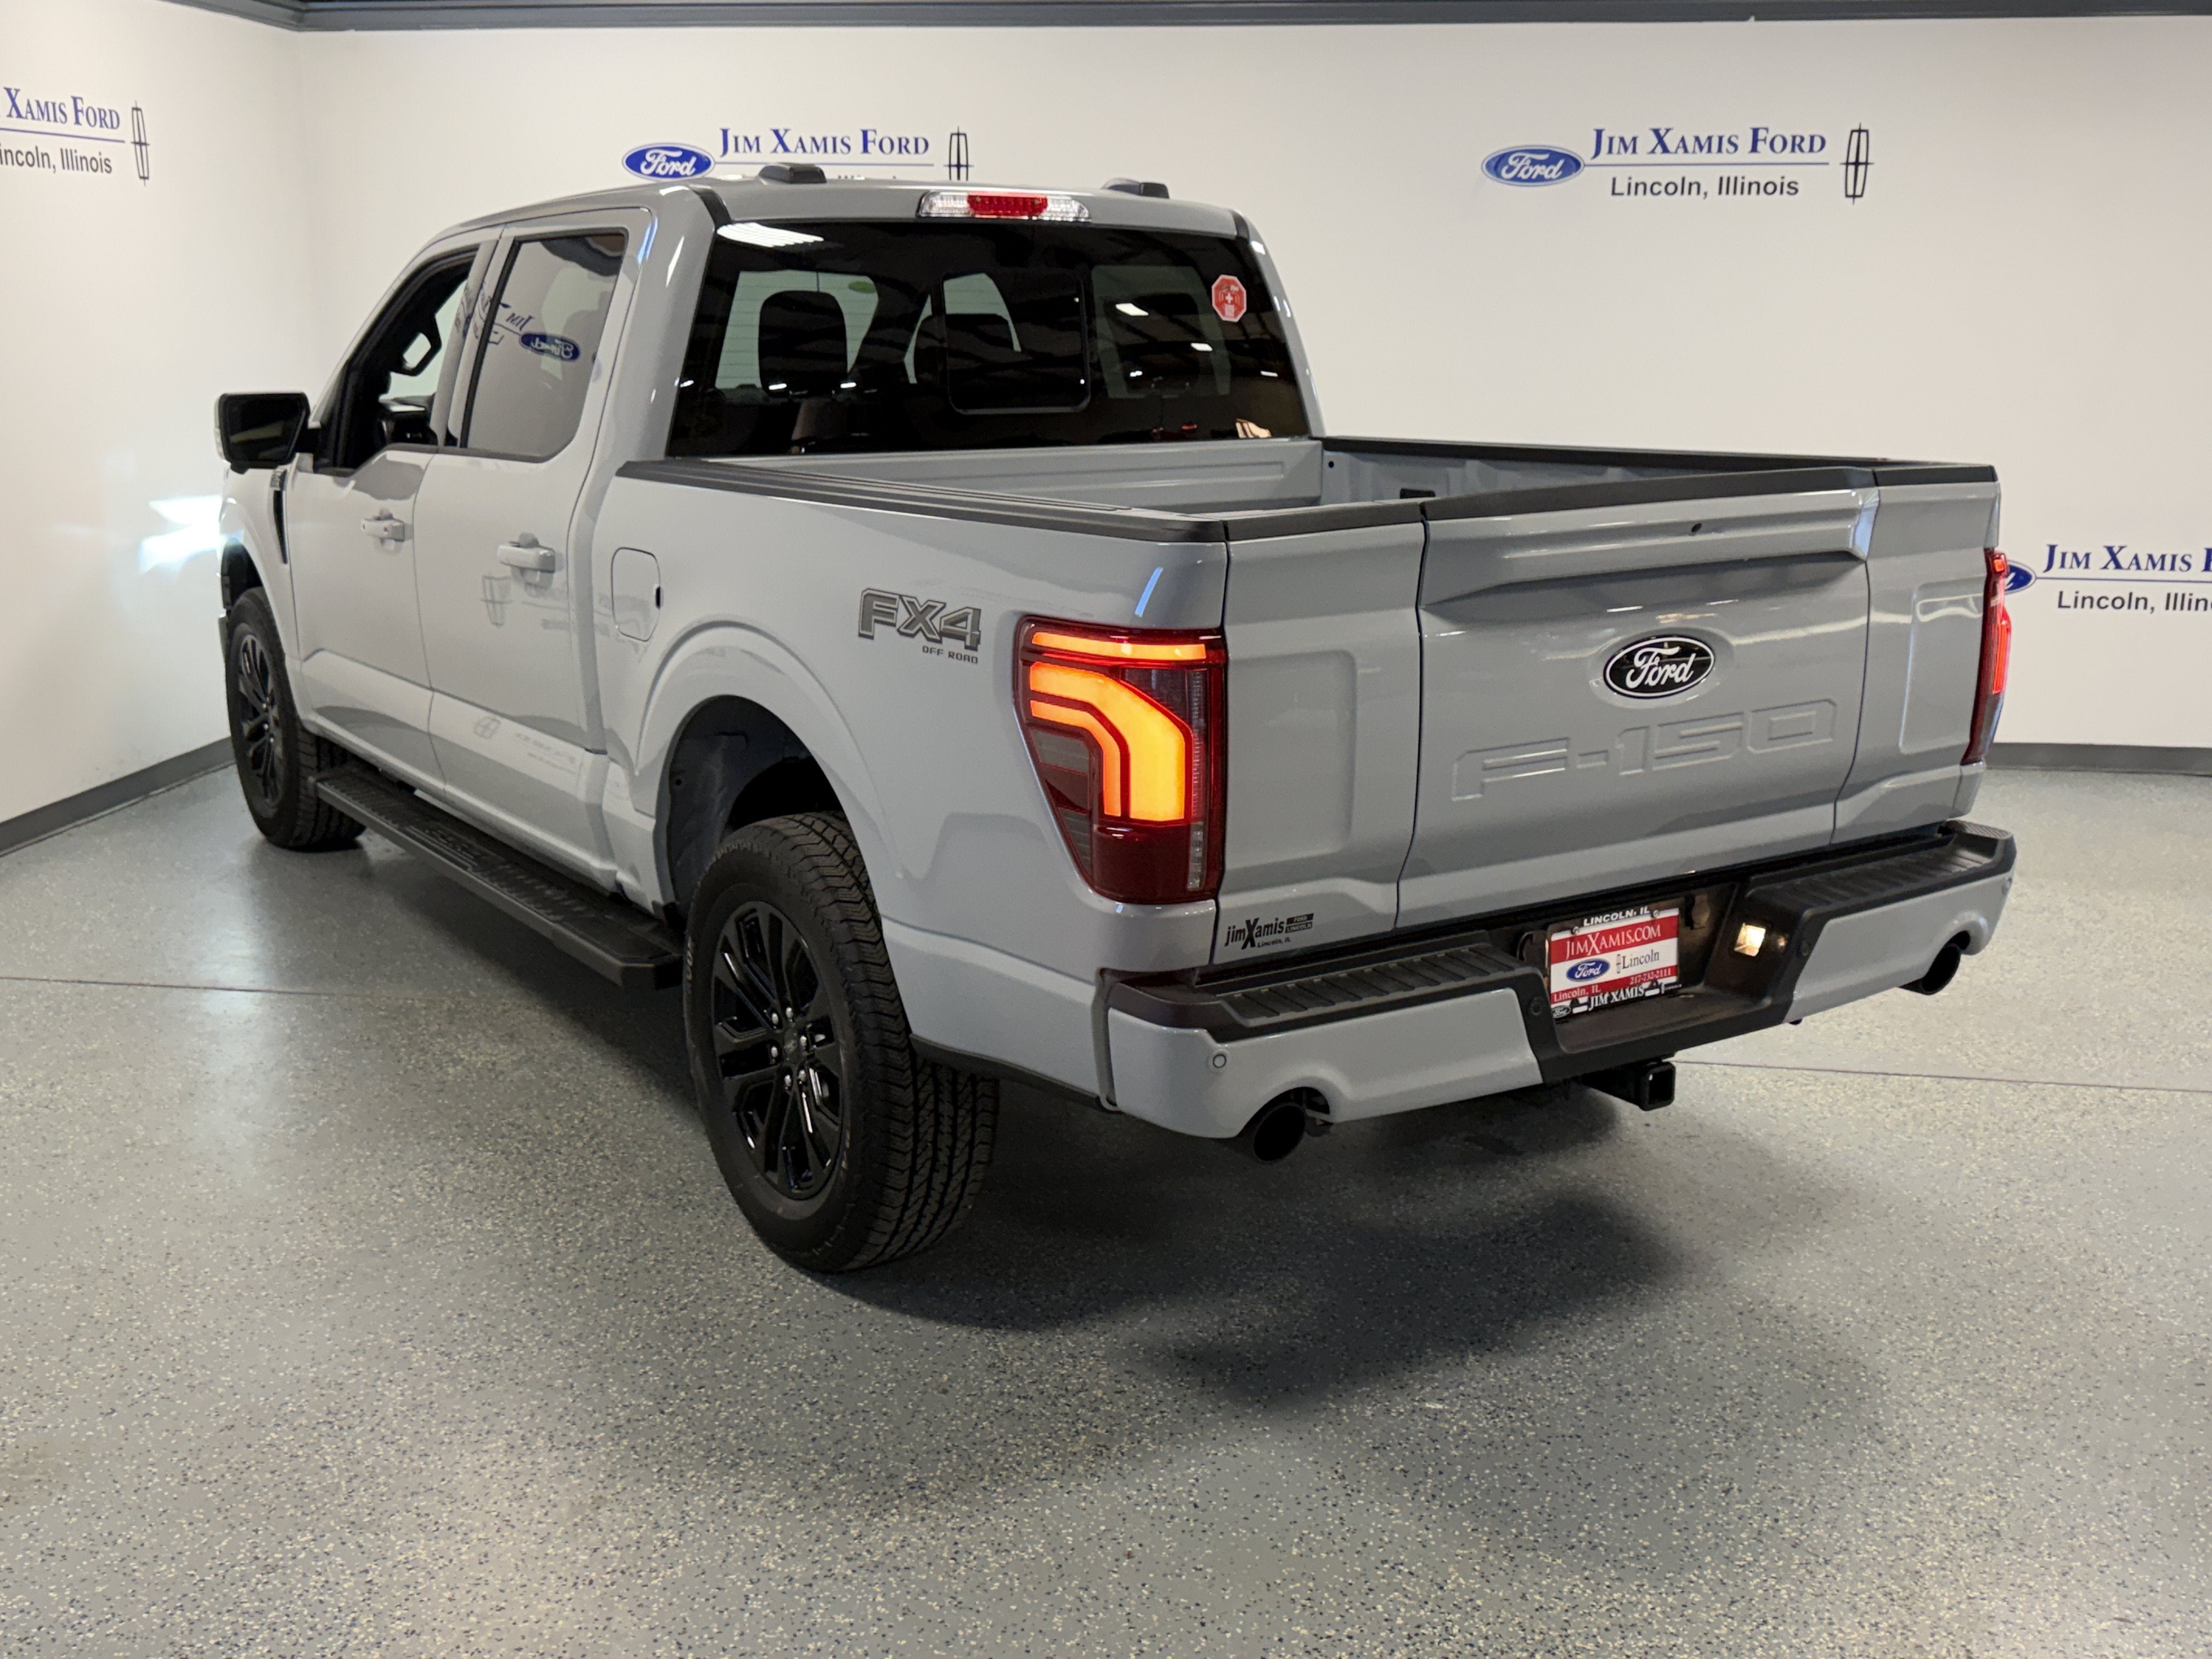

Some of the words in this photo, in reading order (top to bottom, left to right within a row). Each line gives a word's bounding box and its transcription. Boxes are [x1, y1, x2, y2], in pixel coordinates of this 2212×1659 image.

[71, 95, 120, 129] FORD
[720, 128, 761, 157] JIM
[770, 128, 851, 155] XAMIS
[860, 128, 929, 155] FORD
[1590, 128, 1638, 160] JIM
[1646, 127, 1739, 155] XAMIS
[1748, 127, 1826, 154] FORD
[0, 143, 57, 174] incoln,
[60, 148, 112, 174] Illinois
[641, 149, 696, 177] Ford
[1500, 152, 1562, 180] Ford
[1611, 176, 1708, 198] Lincoln,
[1718, 176, 1799, 196] Illinois
[2042, 544, 2092, 573] JIM
[2100, 545, 2192, 573] XAMIS
[2057, 590, 2155, 614] Lincoln,
[2165, 592, 2212, 612] Illin
[858, 588, 981, 652] FX4
[922, 645, 944, 656] OFF
[948, 651, 979, 664] ROAD
[1626, 646, 1694, 689] Ford
[1452, 698, 1837, 802] F-150
[1639, 906, 1651, 916] IL
[1224, 917, 1285, 950] jimXamis
[1566, 924, 1661, 960] JIMXAMIS.COM
[1574, 961, 1601, 979] Ford
[1622, 949, 1660, 969] Lincoln
[1588, 992, 1609, 1011] JIM
[1611, 985, 1645, 1002] XAMIS
